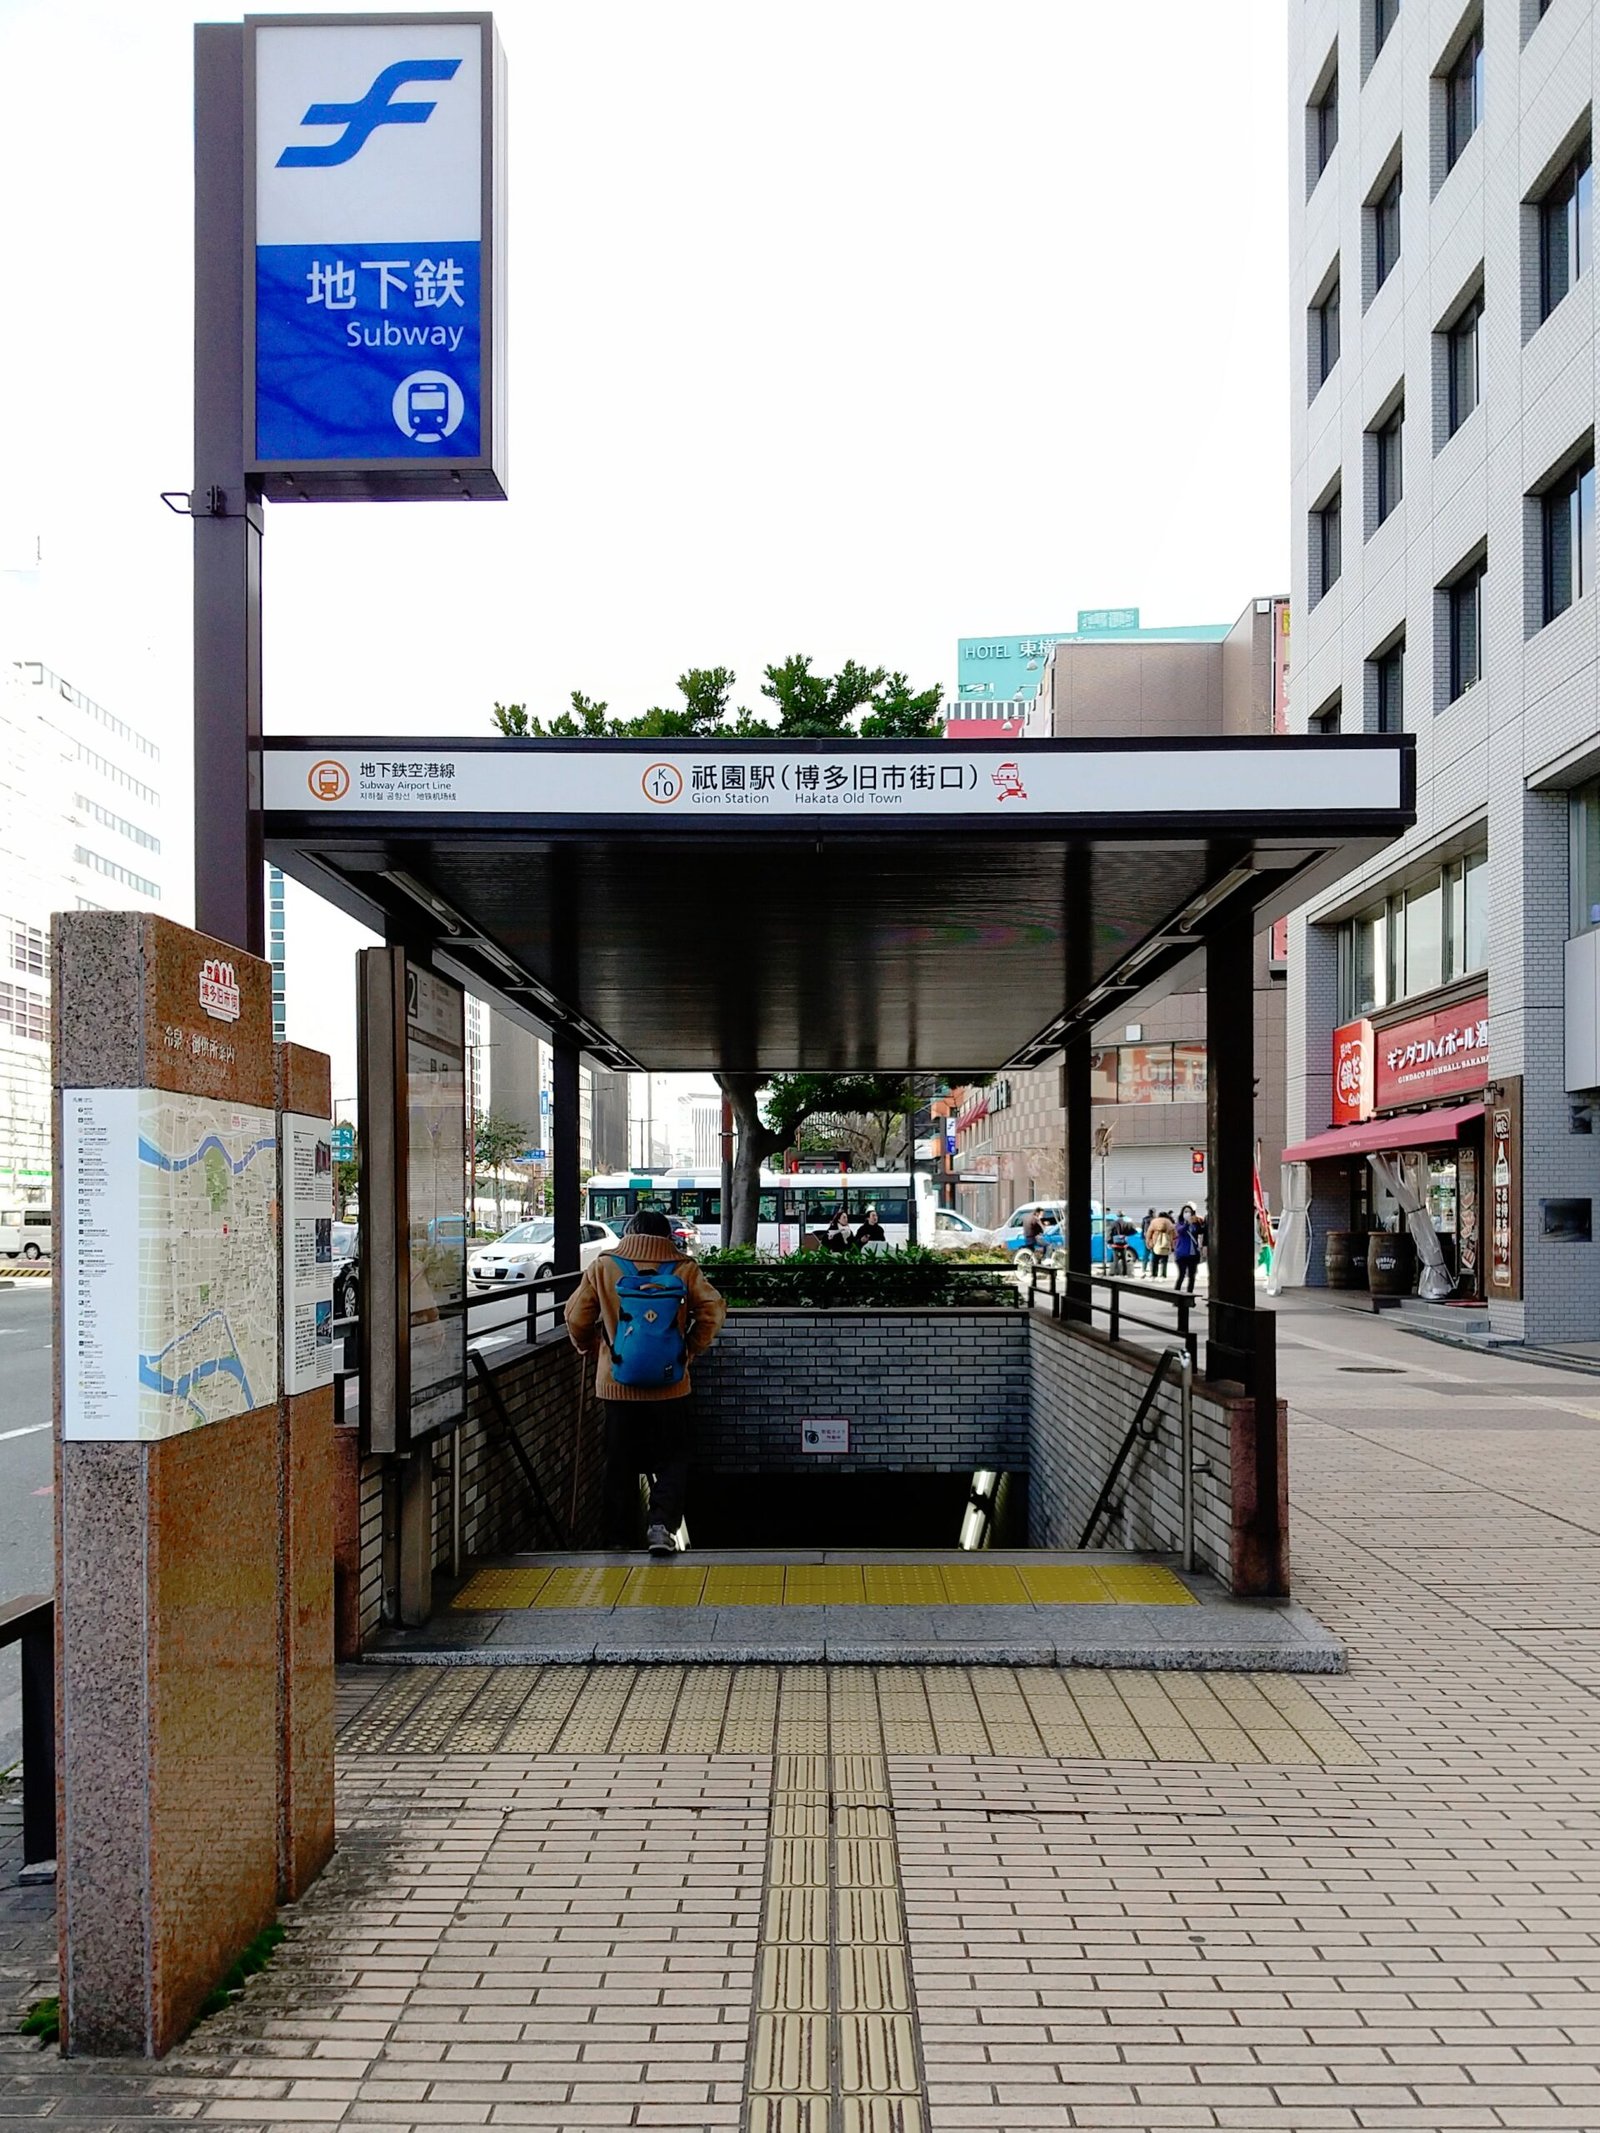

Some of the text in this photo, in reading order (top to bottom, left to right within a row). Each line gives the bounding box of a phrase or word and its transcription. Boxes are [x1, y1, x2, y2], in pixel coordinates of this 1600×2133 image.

[306, 258, 465, 310] 地下鉄
[346, 320, 464, 352] Subway
[965, 645, 1011, 659] HOTEL
[360, 762, 455, 778] 地下鉄空港線
[658, 768, 667, 780] K
[360, 781, 452, 791] Subway Airport Line
[652, 781, 674, 797] 10
[692, 793, 770, 804] Gion Station
[795, 793, 902, 804] Hakata Old Town
[1398, 1070, 1426, 1084] GINDACO
[1426, 1062, 1461, 1077] HIGHBALL
